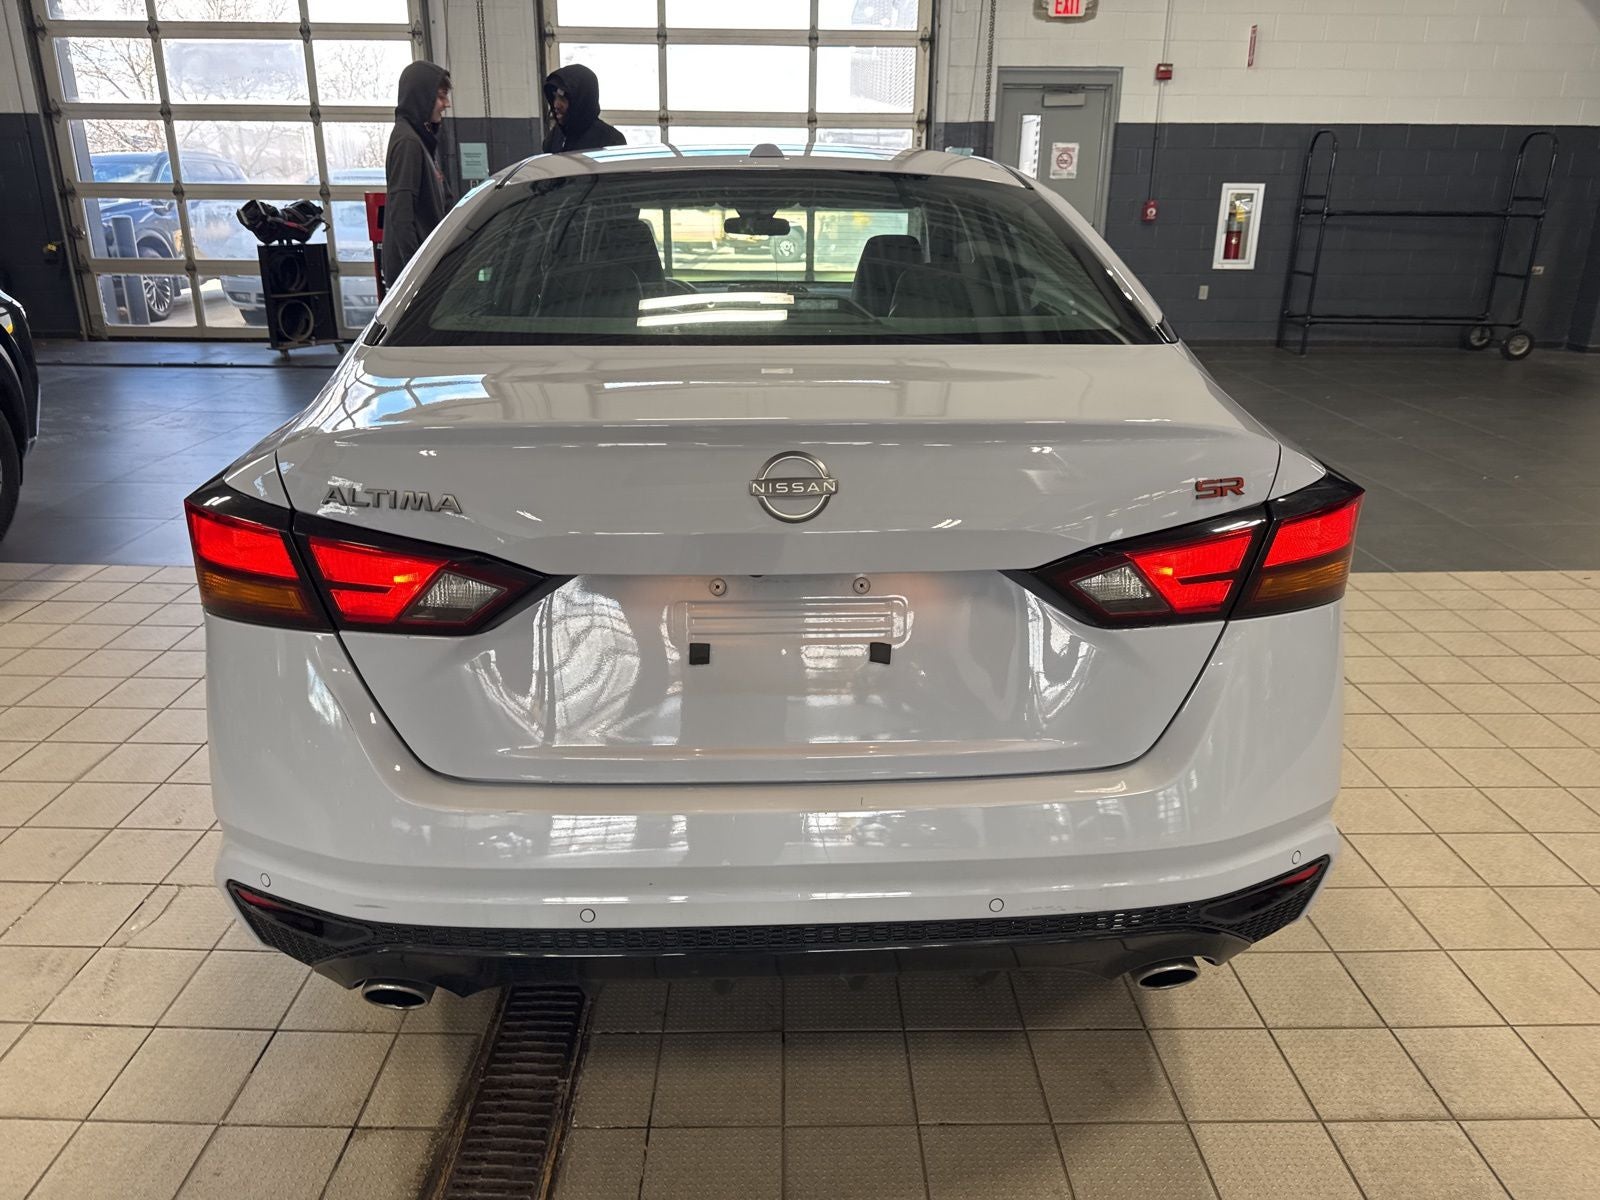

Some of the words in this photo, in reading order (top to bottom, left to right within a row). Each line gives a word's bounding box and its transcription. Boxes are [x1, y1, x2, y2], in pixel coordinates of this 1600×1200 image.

[752, 482, 836, 493] NISSAN
[1195, 477, 1245, 500] SR
[321, 486, 463, 514] ALTIMA
